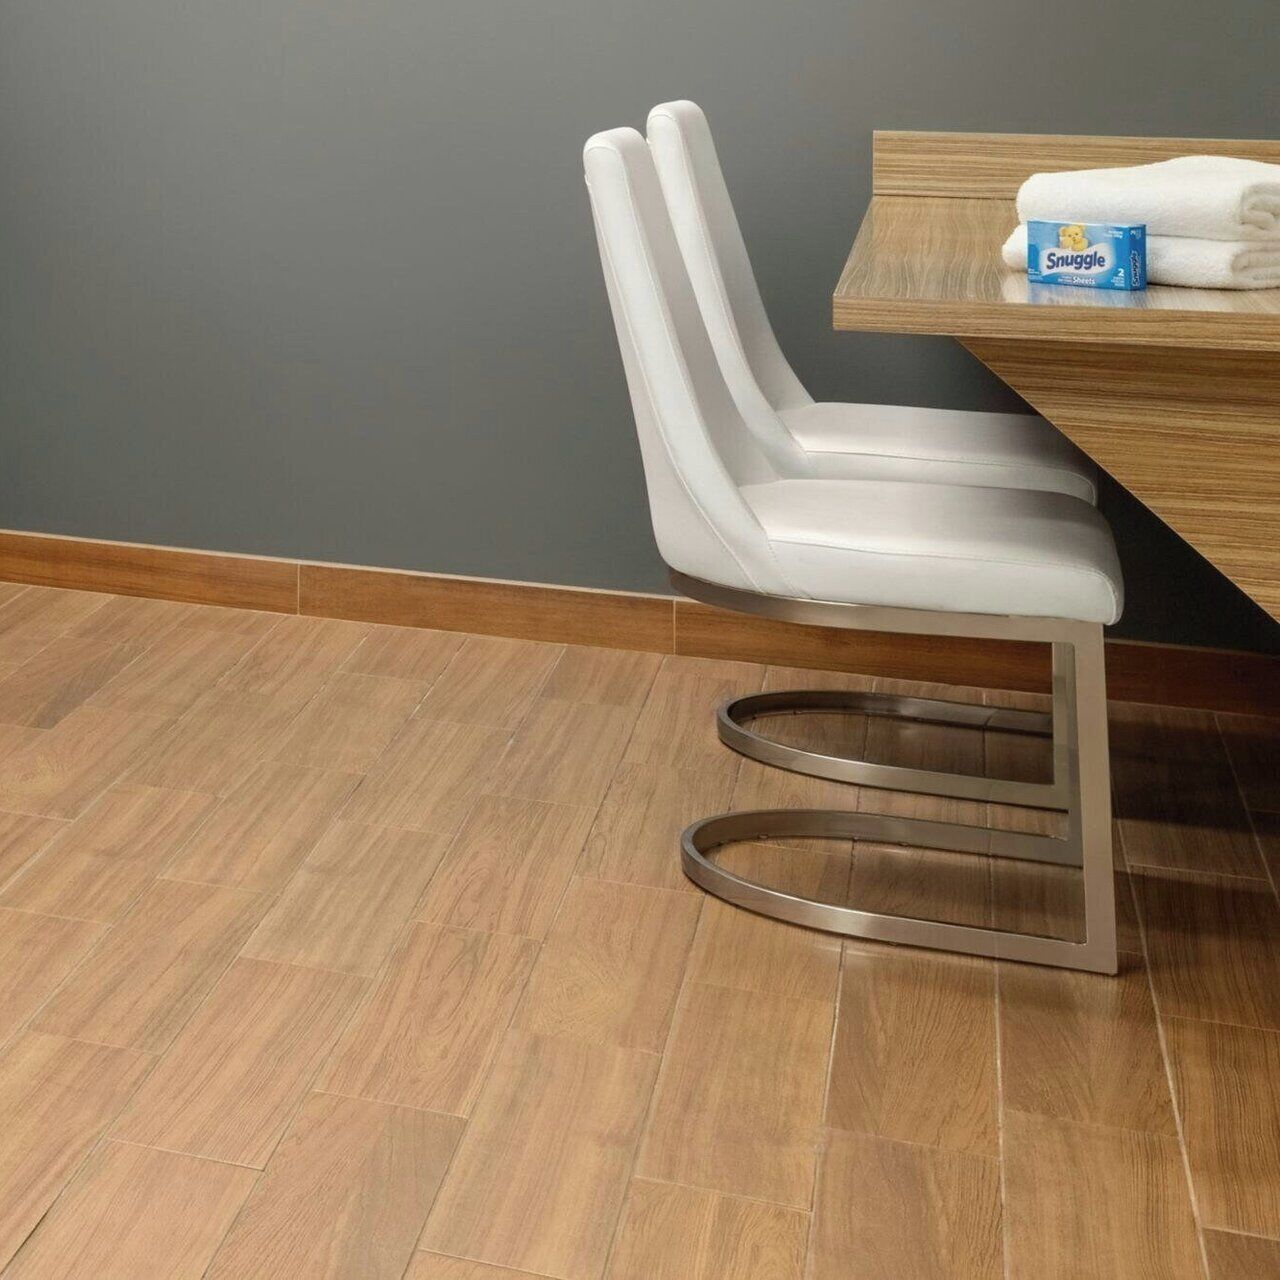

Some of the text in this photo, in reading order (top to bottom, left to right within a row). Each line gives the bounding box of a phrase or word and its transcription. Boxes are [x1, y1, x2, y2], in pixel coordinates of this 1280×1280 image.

[1046, 250, 1106, 270] Snuggle
[1117, 269, 1124, 277] 2
[1072, 275, 1096, 286] Sheets
